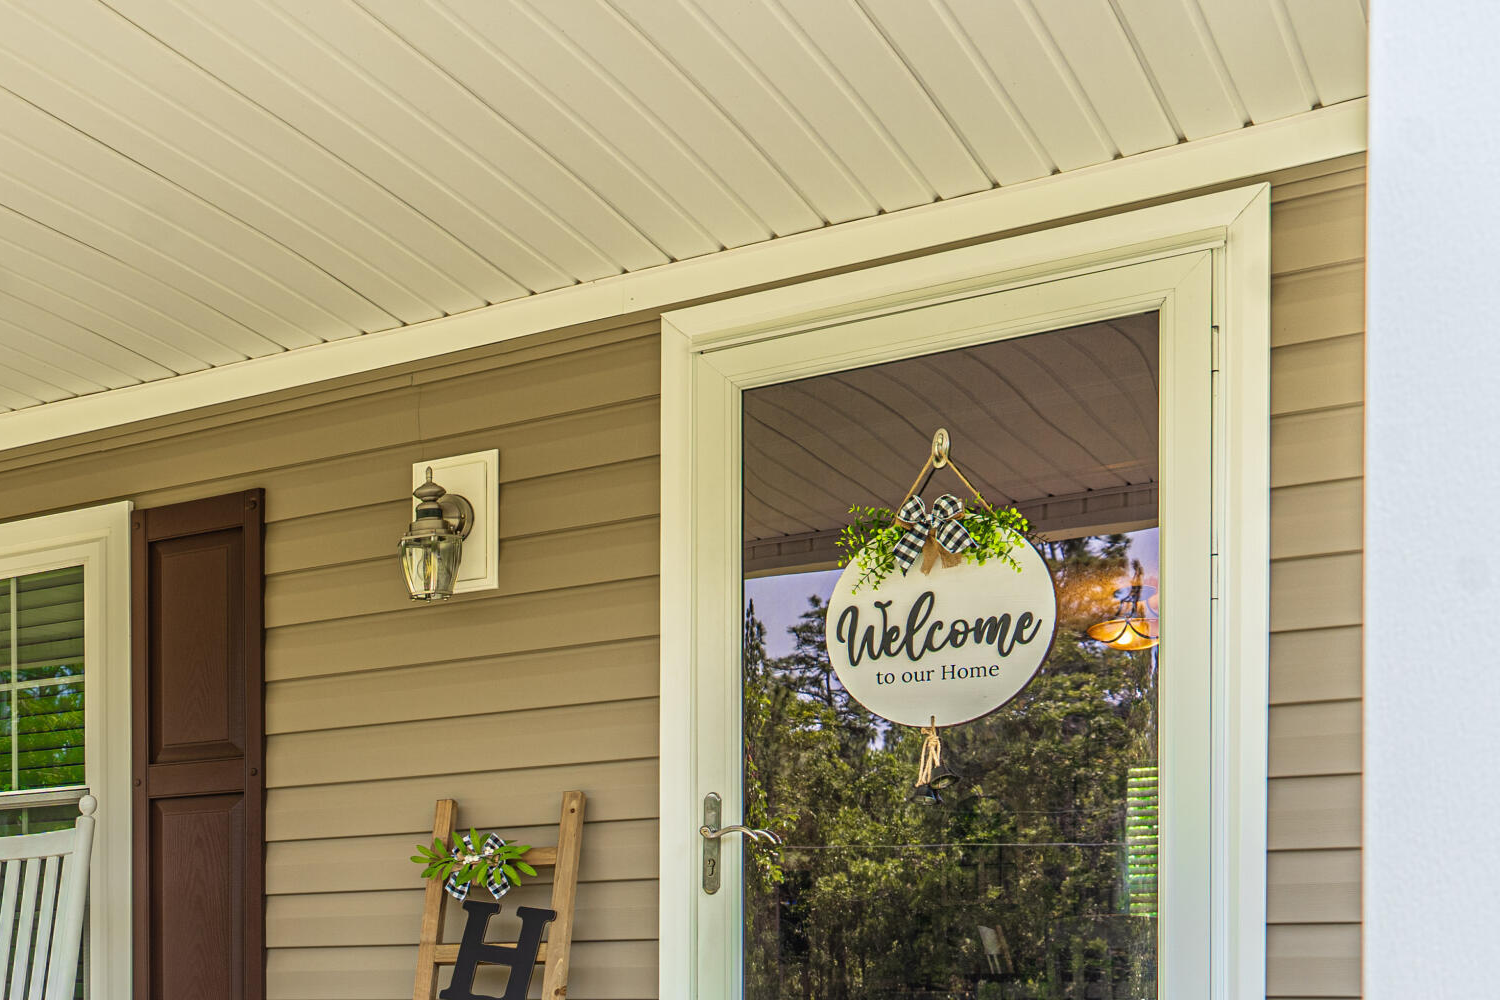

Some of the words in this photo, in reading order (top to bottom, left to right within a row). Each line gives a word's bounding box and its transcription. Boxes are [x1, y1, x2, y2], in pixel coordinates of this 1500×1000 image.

[837, 591, 1042, 667] Welcome
[876, 670, 895, 685] to
[902, 668, 935, 683] our
[941, 664, 1000, 680] Home
